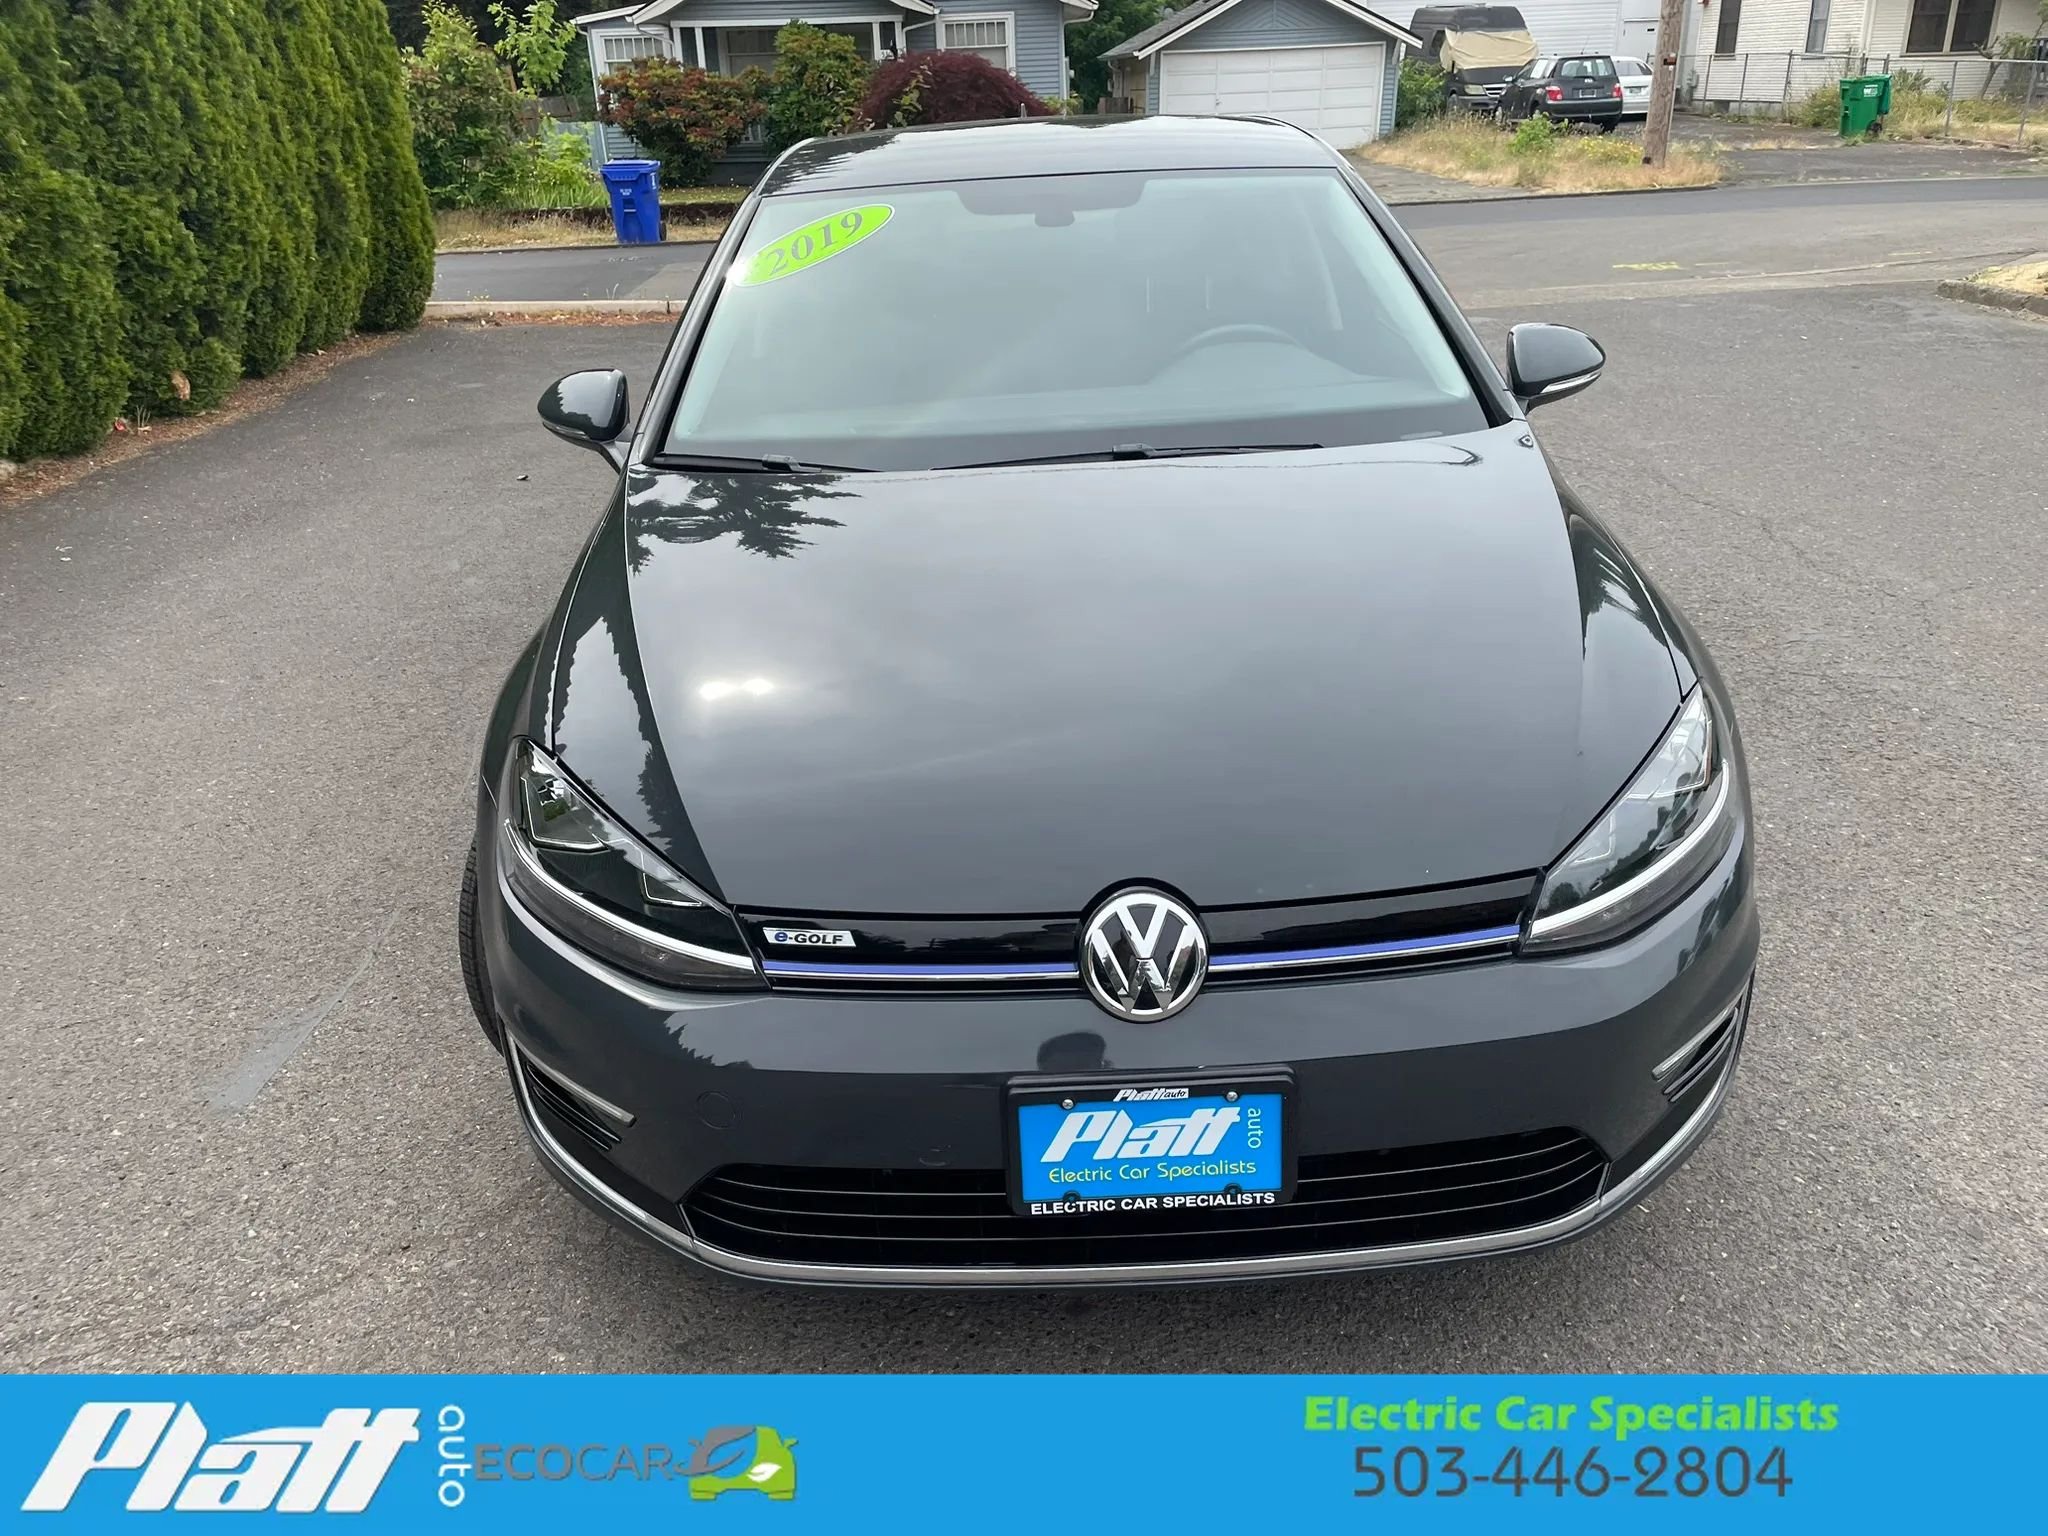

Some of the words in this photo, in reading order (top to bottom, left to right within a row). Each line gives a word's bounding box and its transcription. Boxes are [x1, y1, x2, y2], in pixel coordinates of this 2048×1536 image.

[766, 212, 863, 275] 2019
[774, 931, 844, 944] e-GOLF
[1040, 1106, 1241, 1163] Platt
[1247, 1108, 1265, 1149] auto
[1048, 1165, 1113, 1184] Electric
[1119, 1162, 1150, 1180] Car
[1157, 1159, 1257, 1181] Specialists
[1031, 1198, 1116, 1216] ELECTRIC
[1121, 1196, 1158, 1211] CAR
[1163, 1192, 1276, 1209] SPECIALISTS
